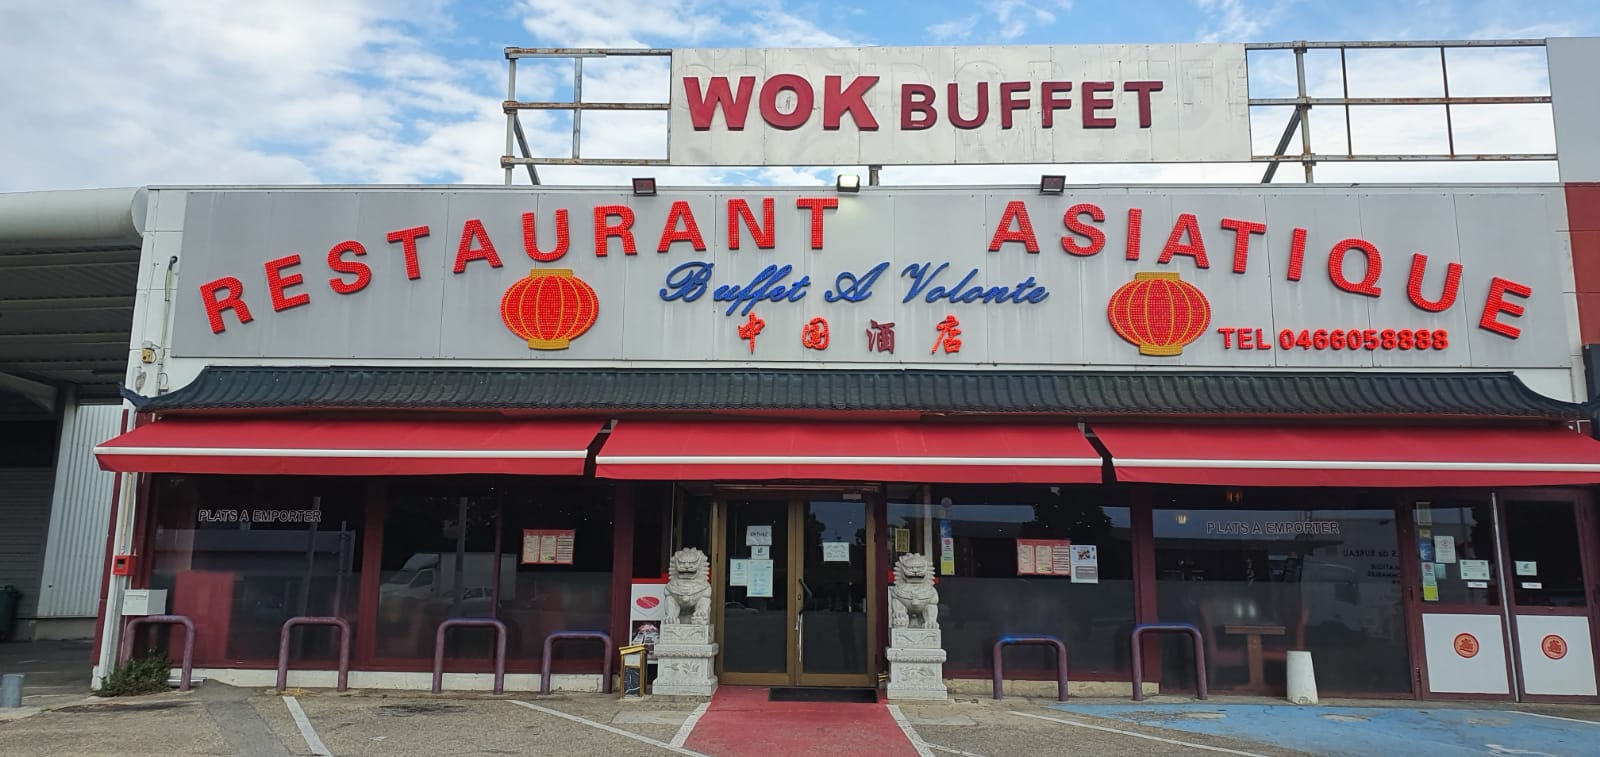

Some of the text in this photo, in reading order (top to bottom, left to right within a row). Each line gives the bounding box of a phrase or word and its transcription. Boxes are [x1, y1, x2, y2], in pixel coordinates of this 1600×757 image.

[683, 74, 879, 131] WOK
[900, 81, 1163, 130] BUFFET
[199, 197, 1533, 340] RESTAURANT ASIATIQUE
[658, 260, 1050, 316] Buffet A Volonte
[1217, 327, 1449, 351] TEL 0466058888
[198, 509, 322, 523] PLATS A EMPORTER
[1206, 521, 1341, 536] PLATS A EMPORTER
